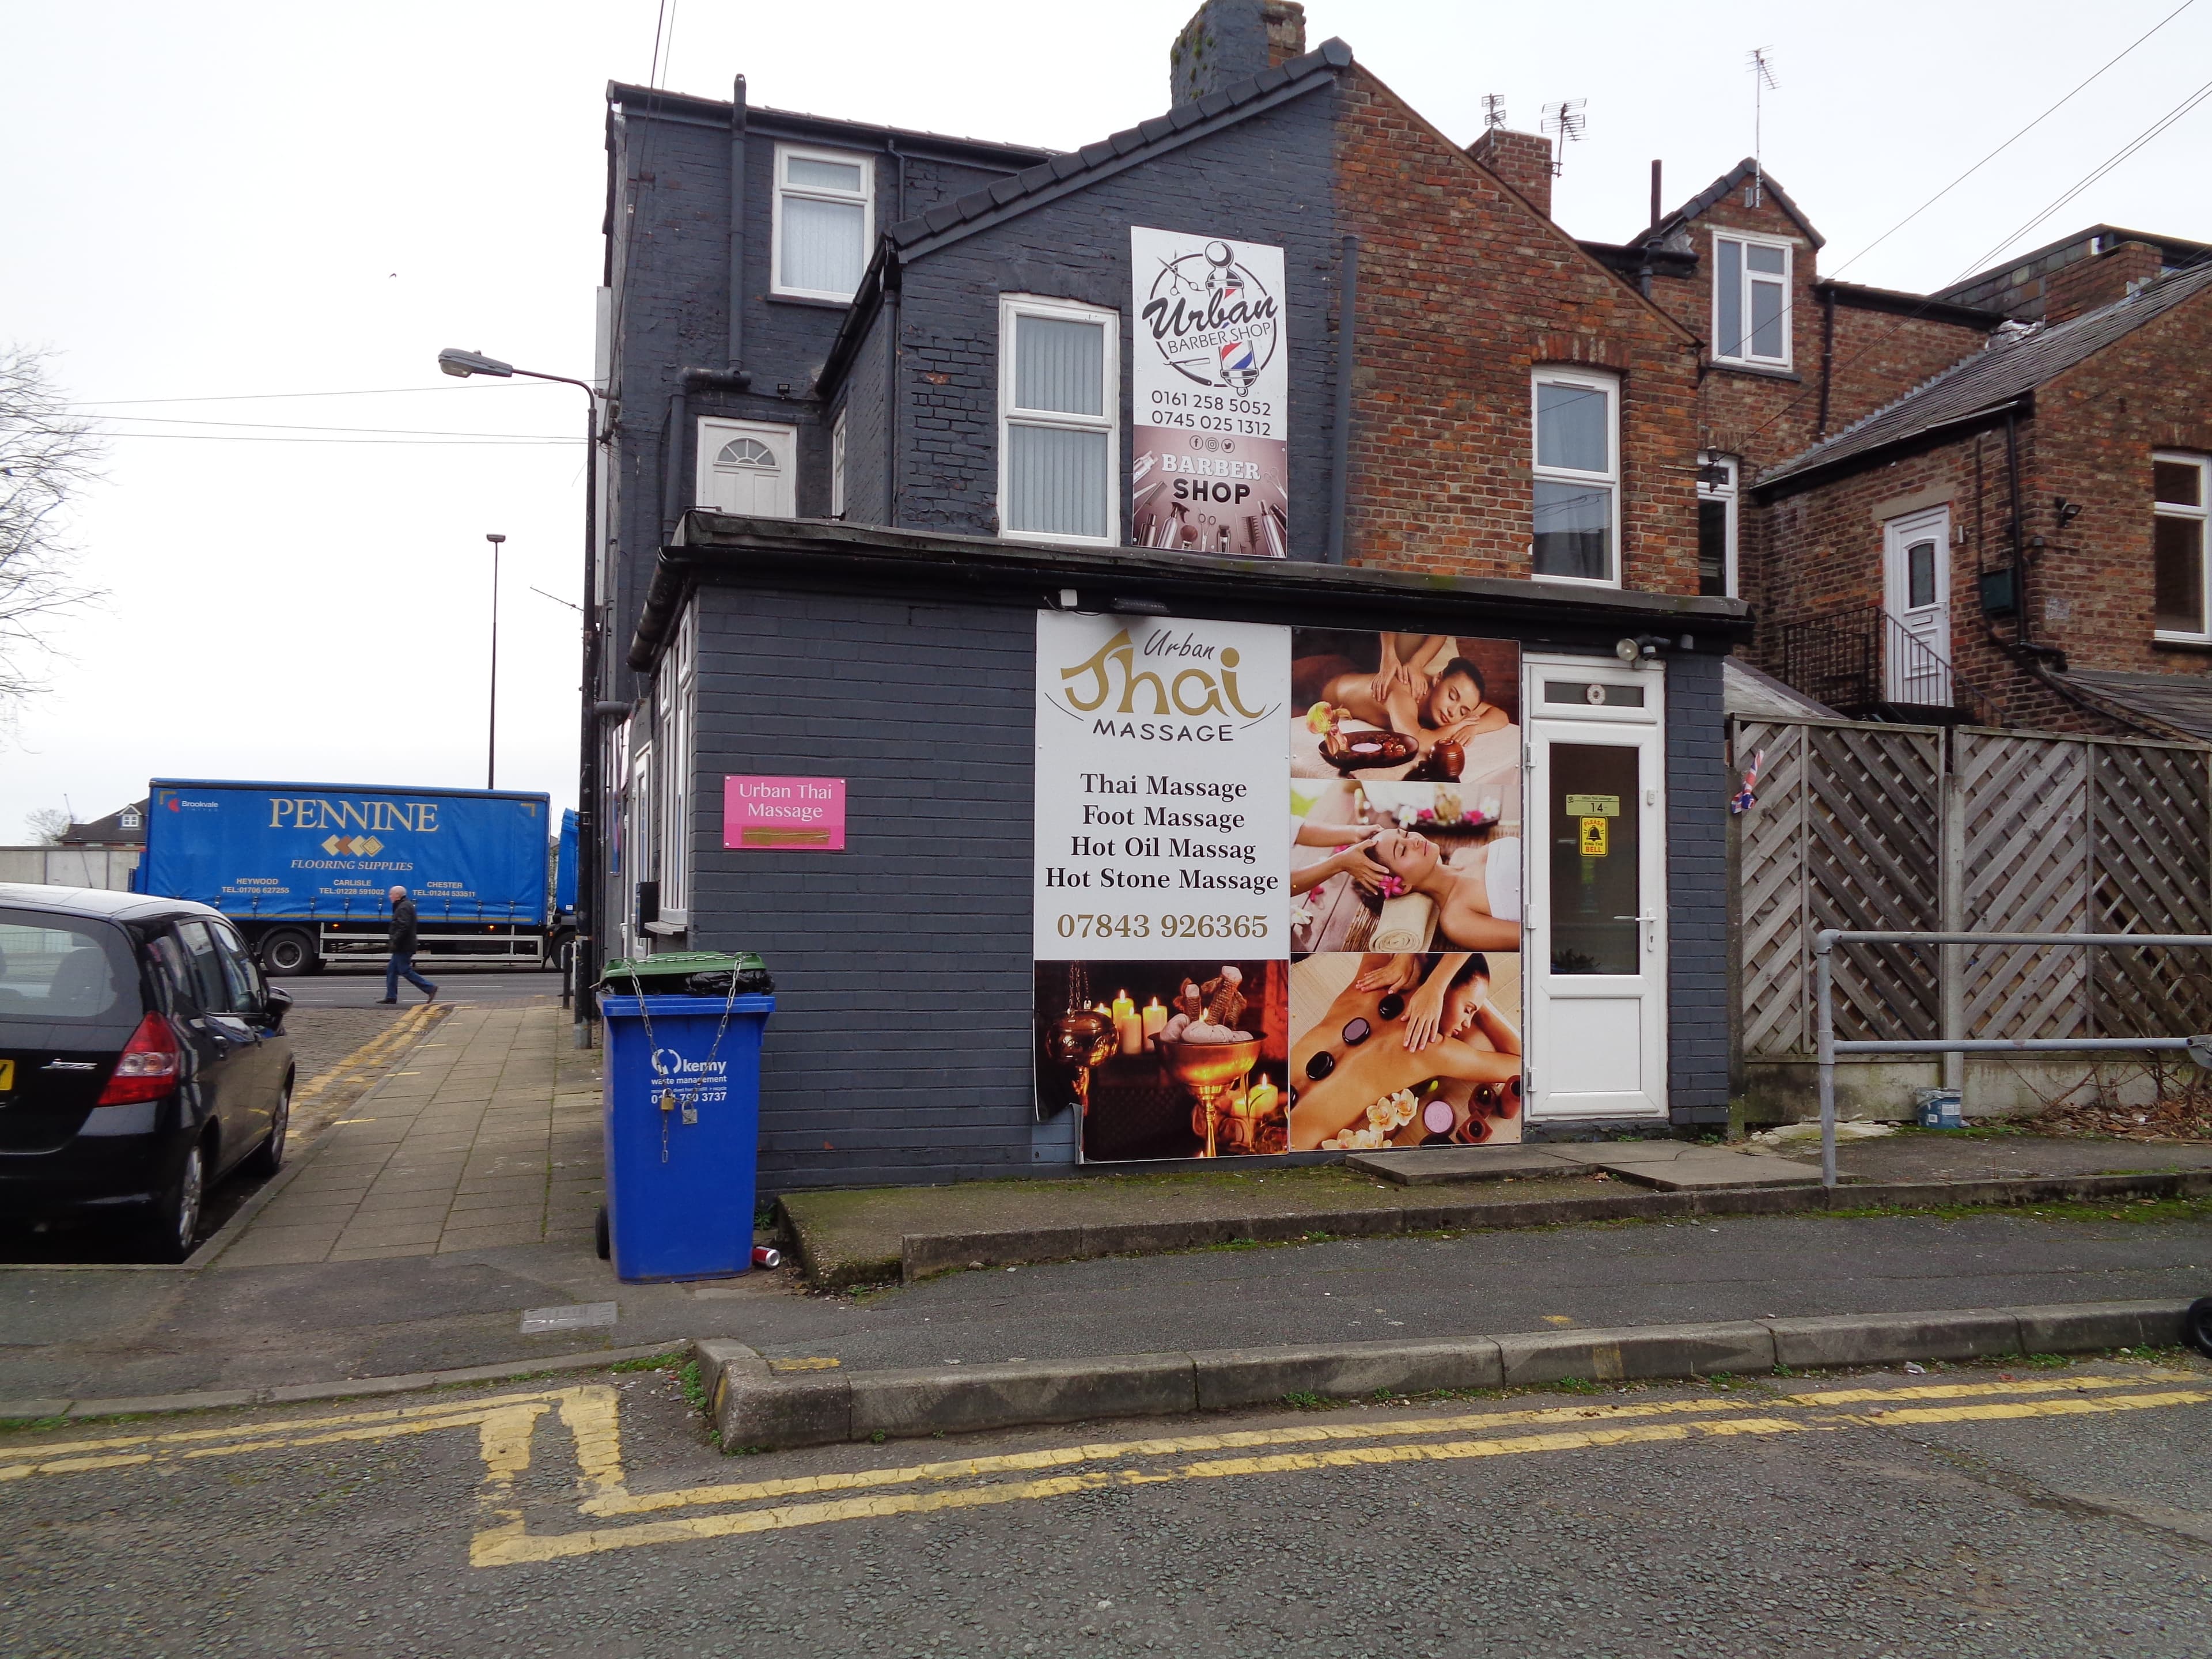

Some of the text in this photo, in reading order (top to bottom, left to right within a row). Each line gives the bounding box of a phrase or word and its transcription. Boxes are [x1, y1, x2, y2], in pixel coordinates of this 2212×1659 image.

[1142, 288, 1278, 339] Urban
[1168, 323, 1271, 354] BARBER SHOP
[1152, 390, 1271, 416] 0161 258 5052
[1152, 411, 1270, 435] 0745 025 1312
[1161, 453, 1261, 480] BARBER
[1173, 478, 1250, 505] SHOP
[1144, 629, 1216, 660] Urban
[1093, 719, 1233, 741] MASSAGE
[739, 782, 832, 799] Urban Thai
[1080, 773, 1248, 802] Thai Massage
[268, 798, 439, 832] PENNINE
[748, 803, 823, 822] Massage
[1082, 805, 1245, 833] Foot Massage
[1591, 802, 1603, 812] 14
[1071, 836, 1256, 864] Hot Oil Massag
[290, 859, 413, 871] FLOORING SUPPLIES
[1046, 868, 1279, 895] Hot Stone Massage
[1057, 914, 1268, 938] 07843 926365
[702, 1092, 727, 1101] 3737
